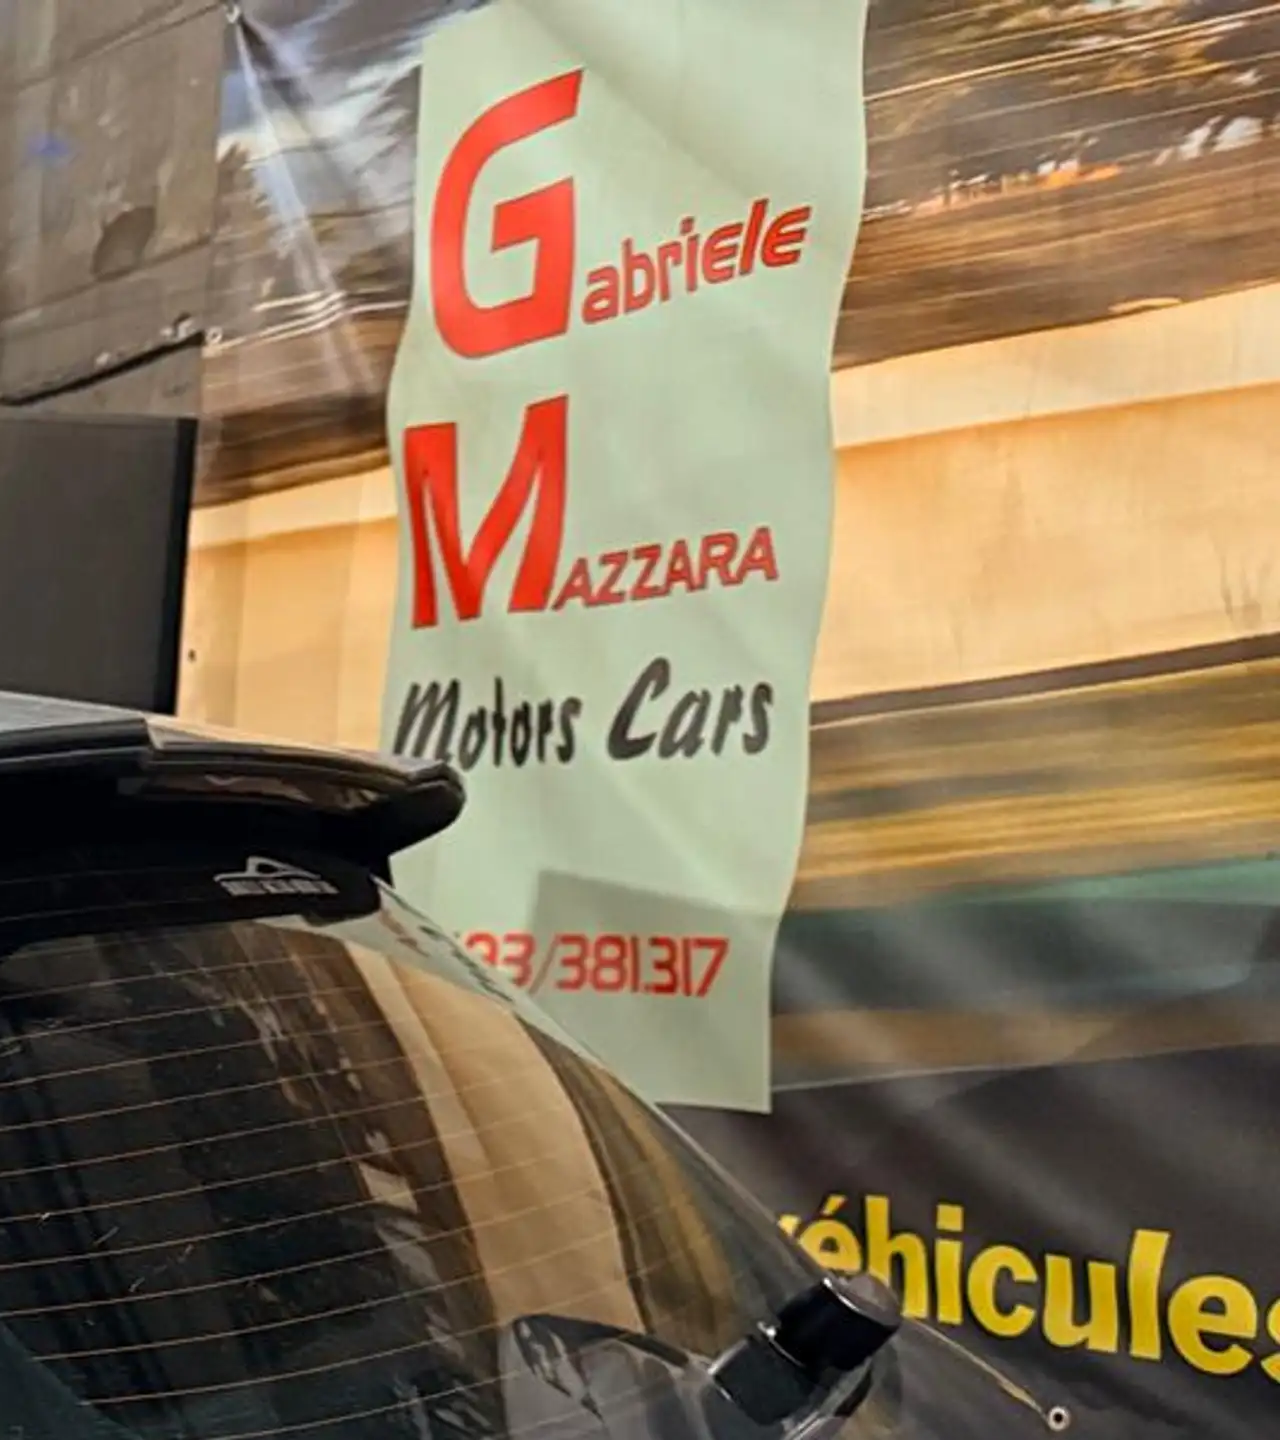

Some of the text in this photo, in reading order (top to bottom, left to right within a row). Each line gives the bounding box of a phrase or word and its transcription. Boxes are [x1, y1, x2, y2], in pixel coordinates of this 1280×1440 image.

[403, 394, 780, 629] MAZZARA
[393, 656, 774, 771] Motors Cars
